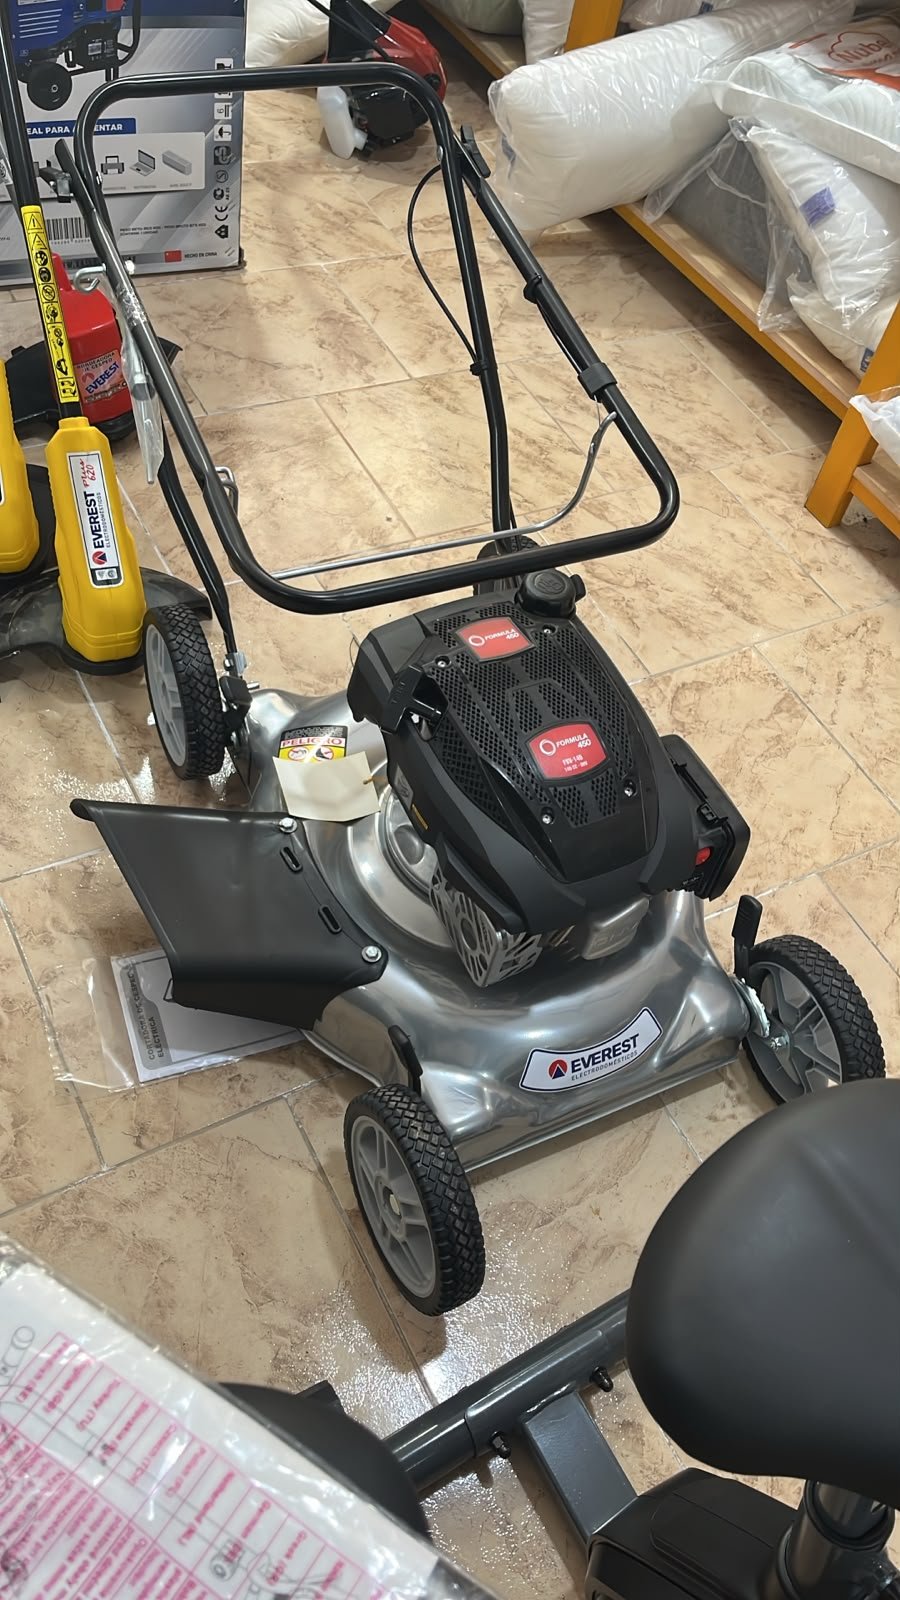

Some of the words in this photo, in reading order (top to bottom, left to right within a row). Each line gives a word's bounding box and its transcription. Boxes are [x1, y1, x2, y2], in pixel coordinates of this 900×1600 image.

[45, 126, 70, 134] PARA
[86, 362, 119, 394] EVEREST
[86, 464, 96, 481] 620
[84, 491, 104, 548] EVEREST
[485, 628, 516, 640] FORMULA
[506, 632, 519, 640] 450
[556, 733, 588, 748] FORMULA
[577, 738, 592, 749] 450
[571, 1033, 639, 1073] EVEREST
